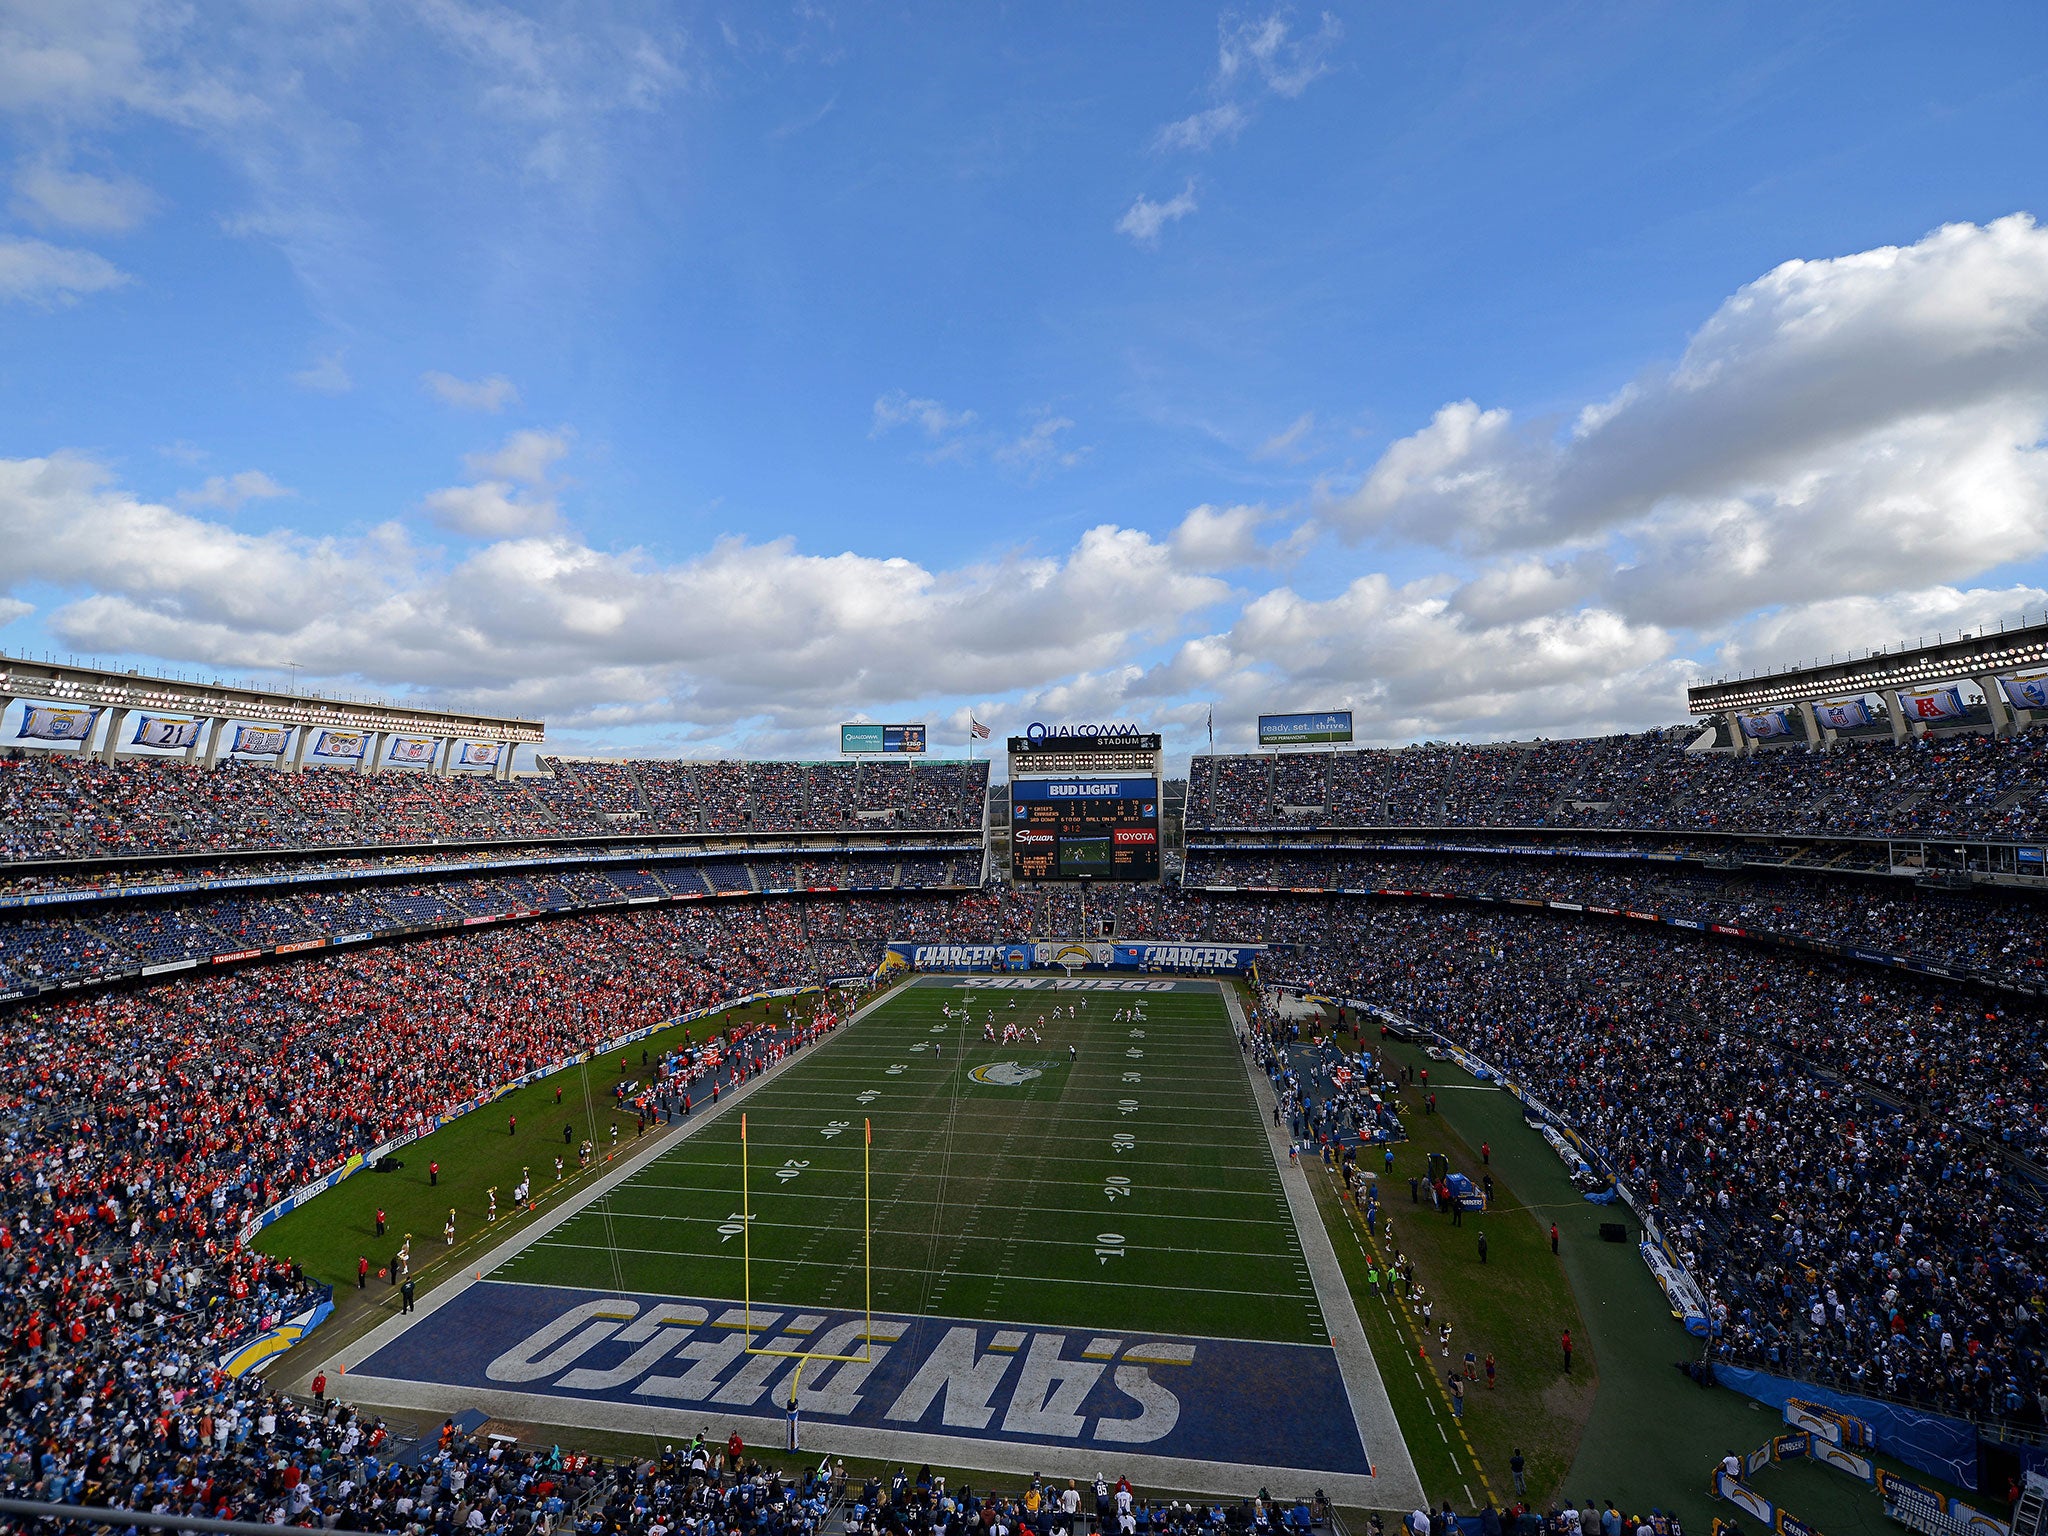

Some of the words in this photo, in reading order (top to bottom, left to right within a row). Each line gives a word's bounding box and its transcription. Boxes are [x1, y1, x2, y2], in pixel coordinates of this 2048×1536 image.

[53, 723, 69, 731] 50
[1263, 723, 1290, 732] ready.
[1293, 723, 1309, 731] set.
[1316, 722, 1347, 730] thrive.
[159, 724, 184, 744] 21
[1027, 722, 1140, 746] QUALCOMM
[1098, 737, 1139, 745] STADIUM
[1050, 785, 1078, 796] BUD
[1079, 784, 1118, 795] LIGHT
[1015, 830, 1055, 845] Sycuan
[1117, 833, 1154, 841] TOYOTA
[158, 884, 180, 892] FOUTS
[68, 891, 96, 901] FAISON
[1630, 911, 1654, 920] CYMER
[1674, 919, 1698, 929] GEICO
[1718, 925, 1740, 935] TOYOTA
[341, 933, 367, 943] GEICO
[283, 940, 319, 952] CYMER
[214, 953, 245, 963] TOSHIBA
[915, 946, 1007, 966] CHARGERS
[1144, 946, 1240, 968] CHARGERS
[1926, 966, 1951, 976] FANDUEL
[952, 978, 1048, 989] SAN
[1047, 979, 1177, 991] DIEGO
[885, 1064, 908, 1075] 50
[1122, 1071, 1141, 1082] 50
[856, 1089, 882, 1101] 40
[1117, 1099, 1139, 1112] 40
[820, 1121, 850, 1135] 30
[1111, 1133, 1136, 1149] 30
[775, 1159, 810, 1178] 20
[1104, 1176, 1132, 1197] 20
[292, 1178, 329, 1209] CHARGERS
[717, 1212, 757, 1234] 10
[1094, 1233, 1126, 1257] 10
[485, 1298, 911, 1416] DIEGO
[885, 1326, 1197, 1443] SAN
[1778, 1439, 1805, 1454] CHARGERS
[893, 1478, 902, 1489] 17
[1096, 1485, 1107, 1496] 85
[1885, 1479, 1937, 1507] CHARGERS
[909, 1512, 918, 1520] 54
